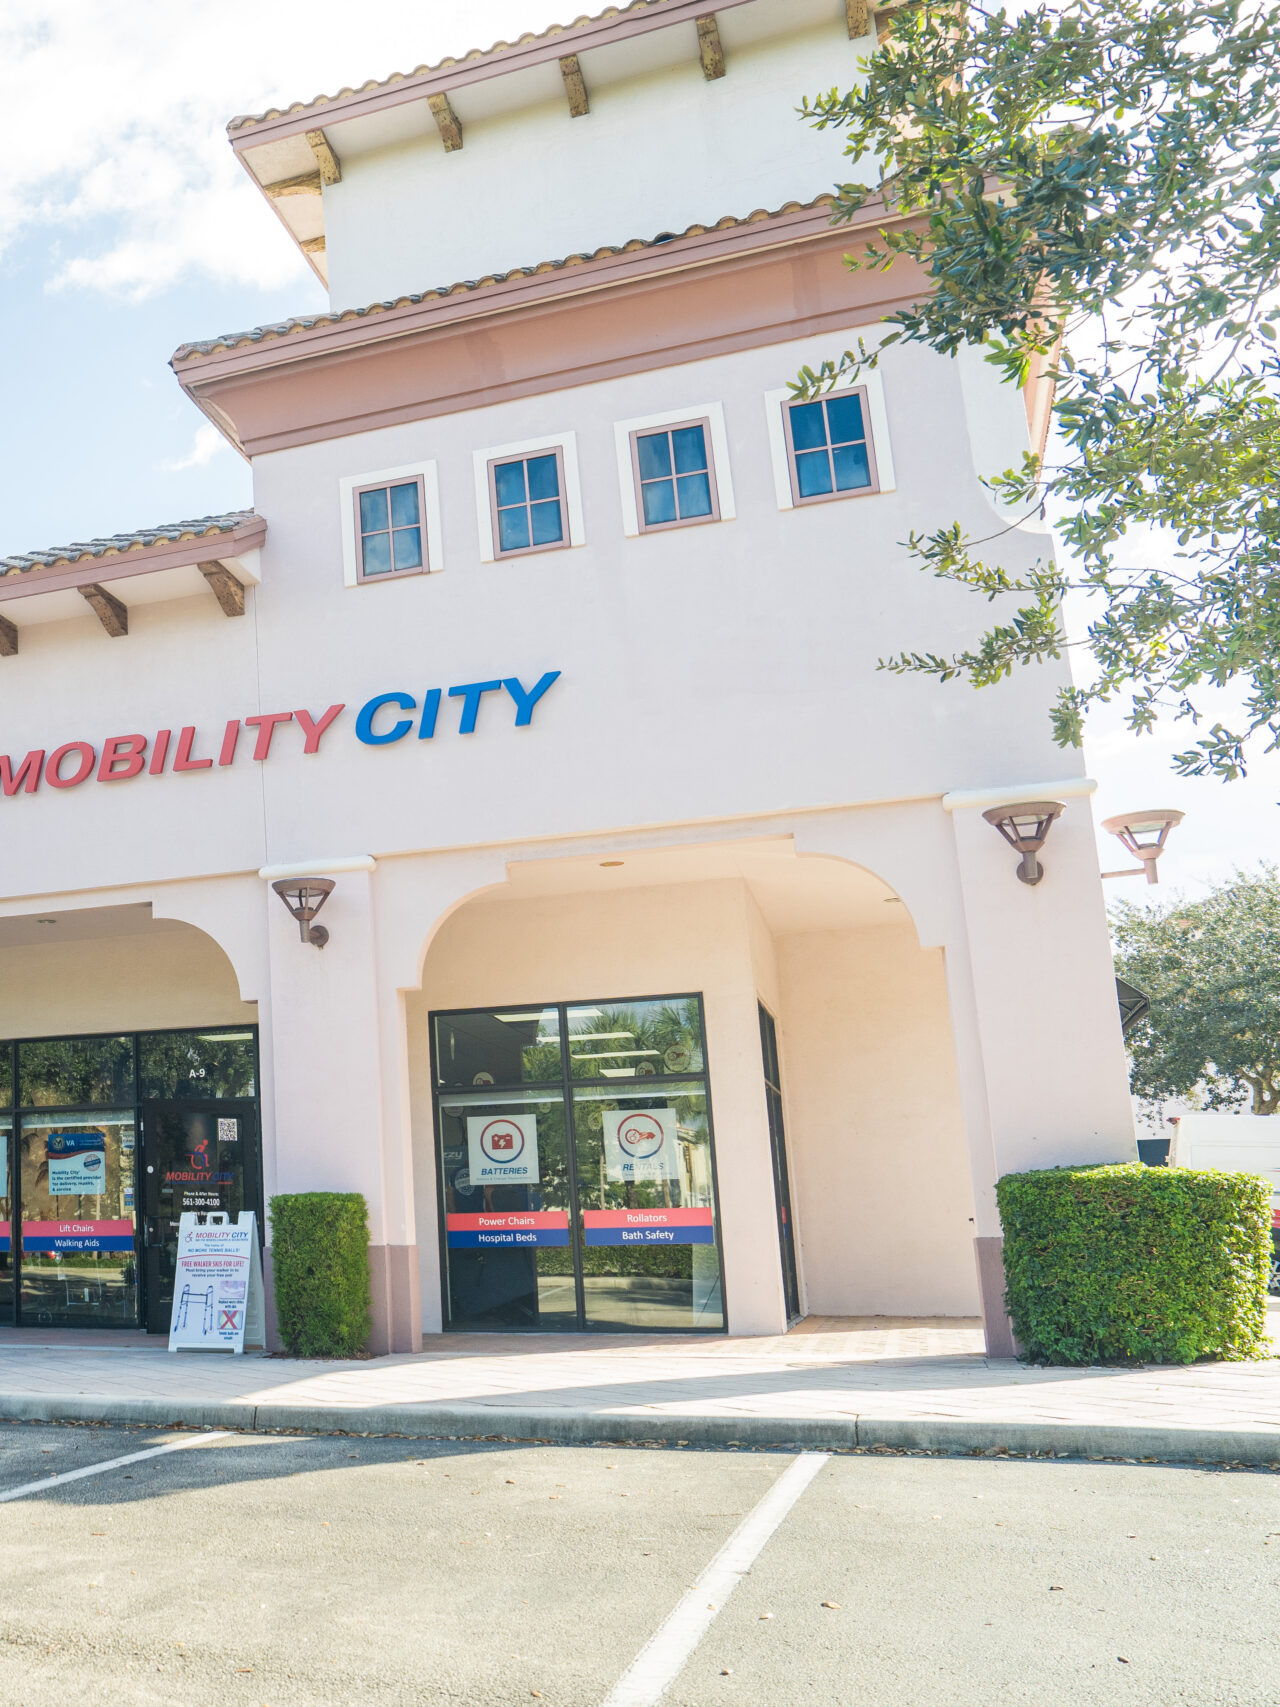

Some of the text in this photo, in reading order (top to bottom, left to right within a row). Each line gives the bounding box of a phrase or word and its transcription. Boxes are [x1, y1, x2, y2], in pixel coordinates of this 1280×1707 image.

[355, 670, 562, 746] CITY
[189, 1068, 206, 1078] A-9
[166, 1171, 234, 1181] MOBILITY CITY
[481, 1167, 528, 1176] BATTERIES
[182, 1198, 220, 1206] 561-300-4100
[479, 1216, 535, 1226] Power Chairs
[627, 1213, 667, 1223] Rollators
[72, 1224, 94, 1232] Chairs
[478, 1233, 537, 1243] Hospital Beds
[622, 1230, 674, 1240] Bath Safety
[55, 1239, 100, 1248] Walking Aids
